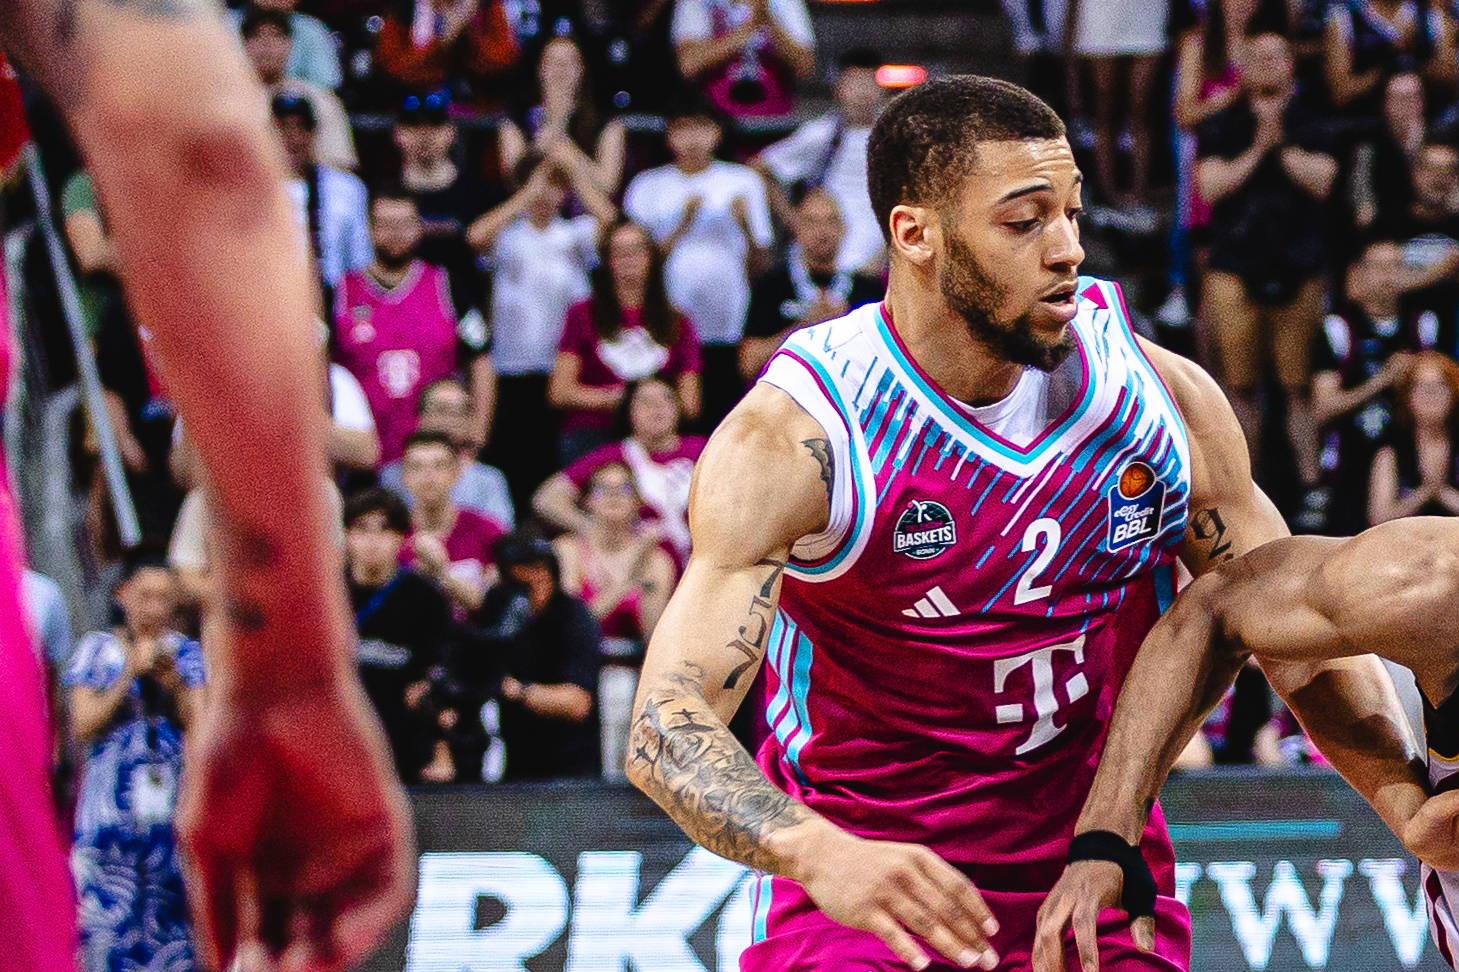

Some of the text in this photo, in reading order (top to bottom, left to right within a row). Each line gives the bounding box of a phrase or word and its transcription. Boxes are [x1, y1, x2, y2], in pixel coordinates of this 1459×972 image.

[897, 526, 951, 549] BASKETS
[1112, 517, 1151, 544] BBL
[1014, 518, 1062, 605] 2
[994, 634, 1089, 755] T
